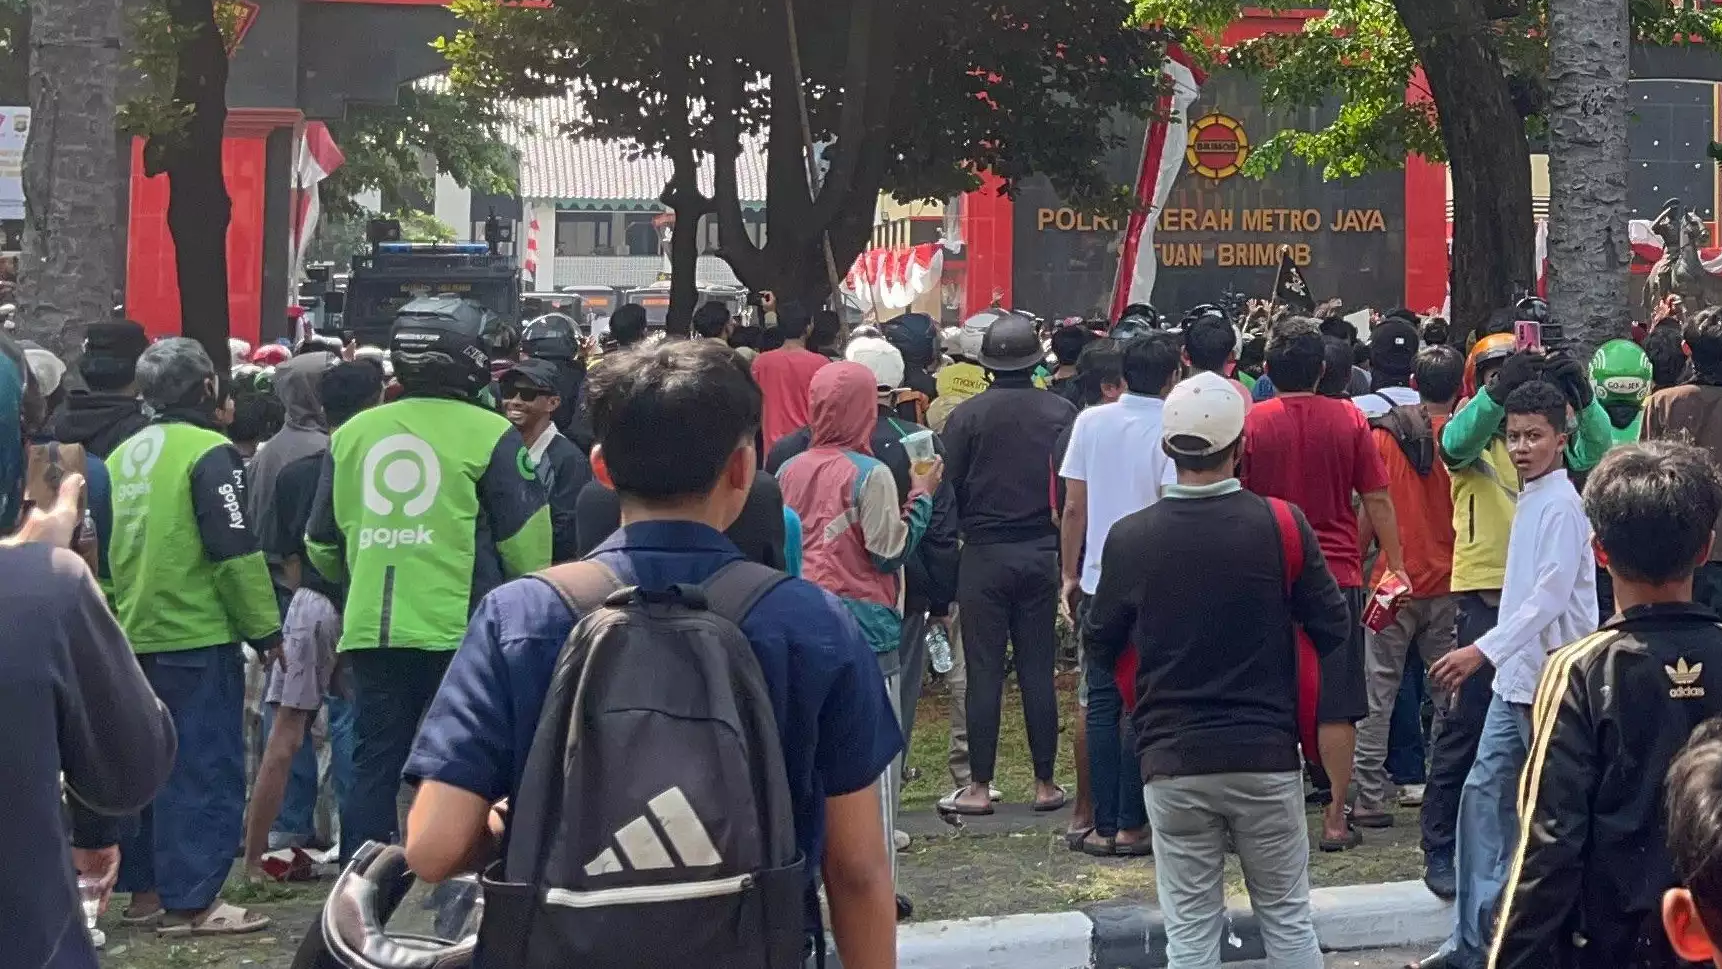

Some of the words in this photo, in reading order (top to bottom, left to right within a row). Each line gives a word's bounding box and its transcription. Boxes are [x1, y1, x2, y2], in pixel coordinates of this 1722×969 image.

[1155, 208, 1233, 231] ERAH
[1242, 209, 1321, 231] METRO
[1330, 209, 1386, 232] JAYA
[1218, 243, 1312, 267] BRIMOB
[218, 483, 246, 529] gopay
[360, 524, 435, 549] gojek
[1669, 686, 1705, 698] adidas
